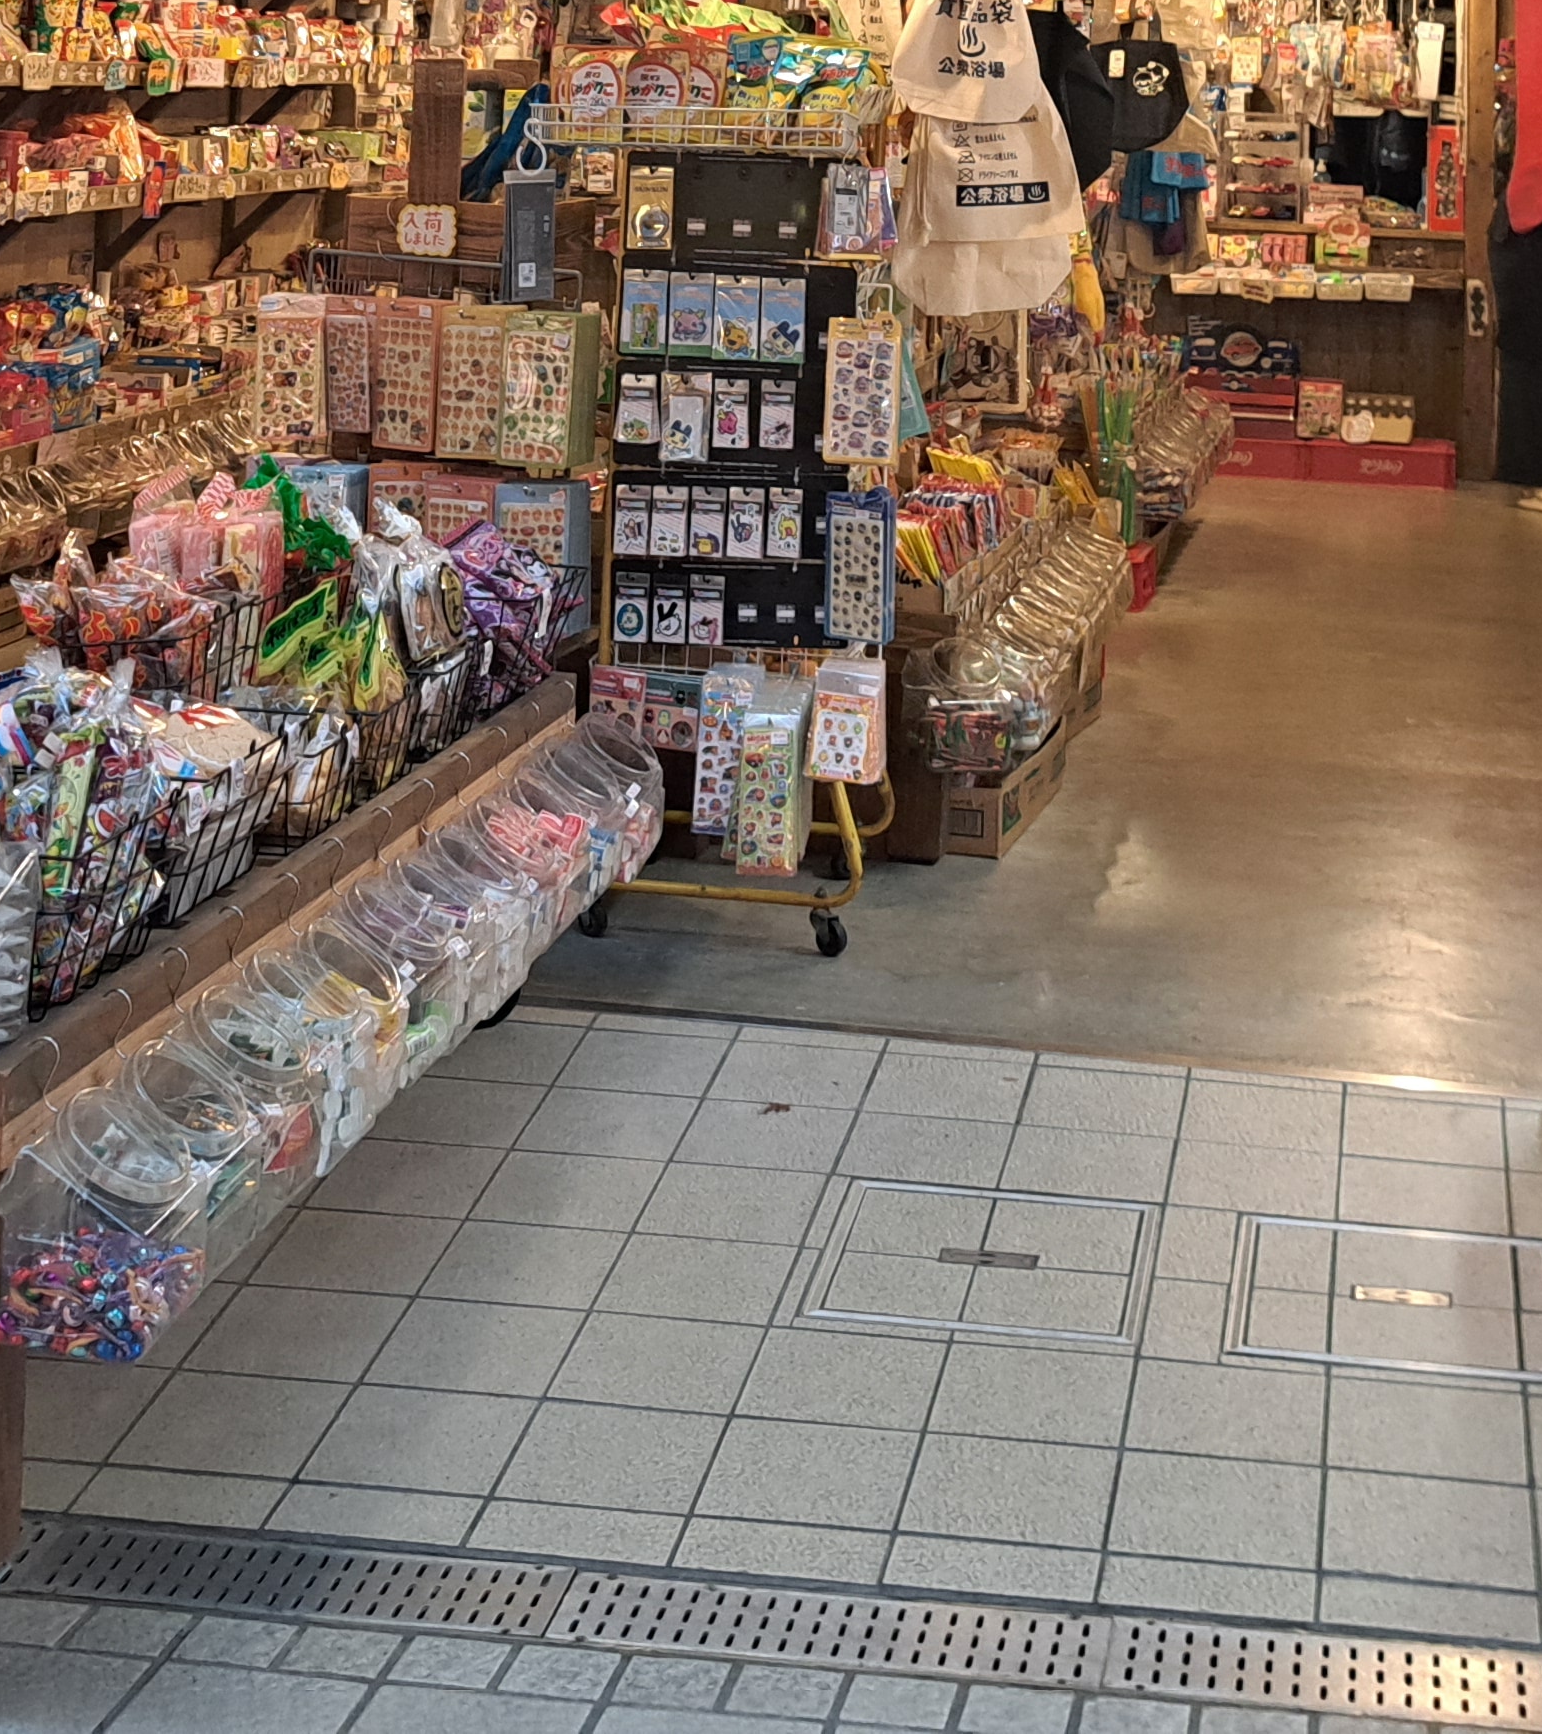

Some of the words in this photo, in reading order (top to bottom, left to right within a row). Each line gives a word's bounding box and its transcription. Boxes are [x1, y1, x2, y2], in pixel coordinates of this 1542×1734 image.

[938, 56, 1006, 79] 公衆浴場
[961, 184, 1025, 205] 公衆浴場
[403, 212, 443, 234] 入荷
[404, 232, 446, 247] しました
